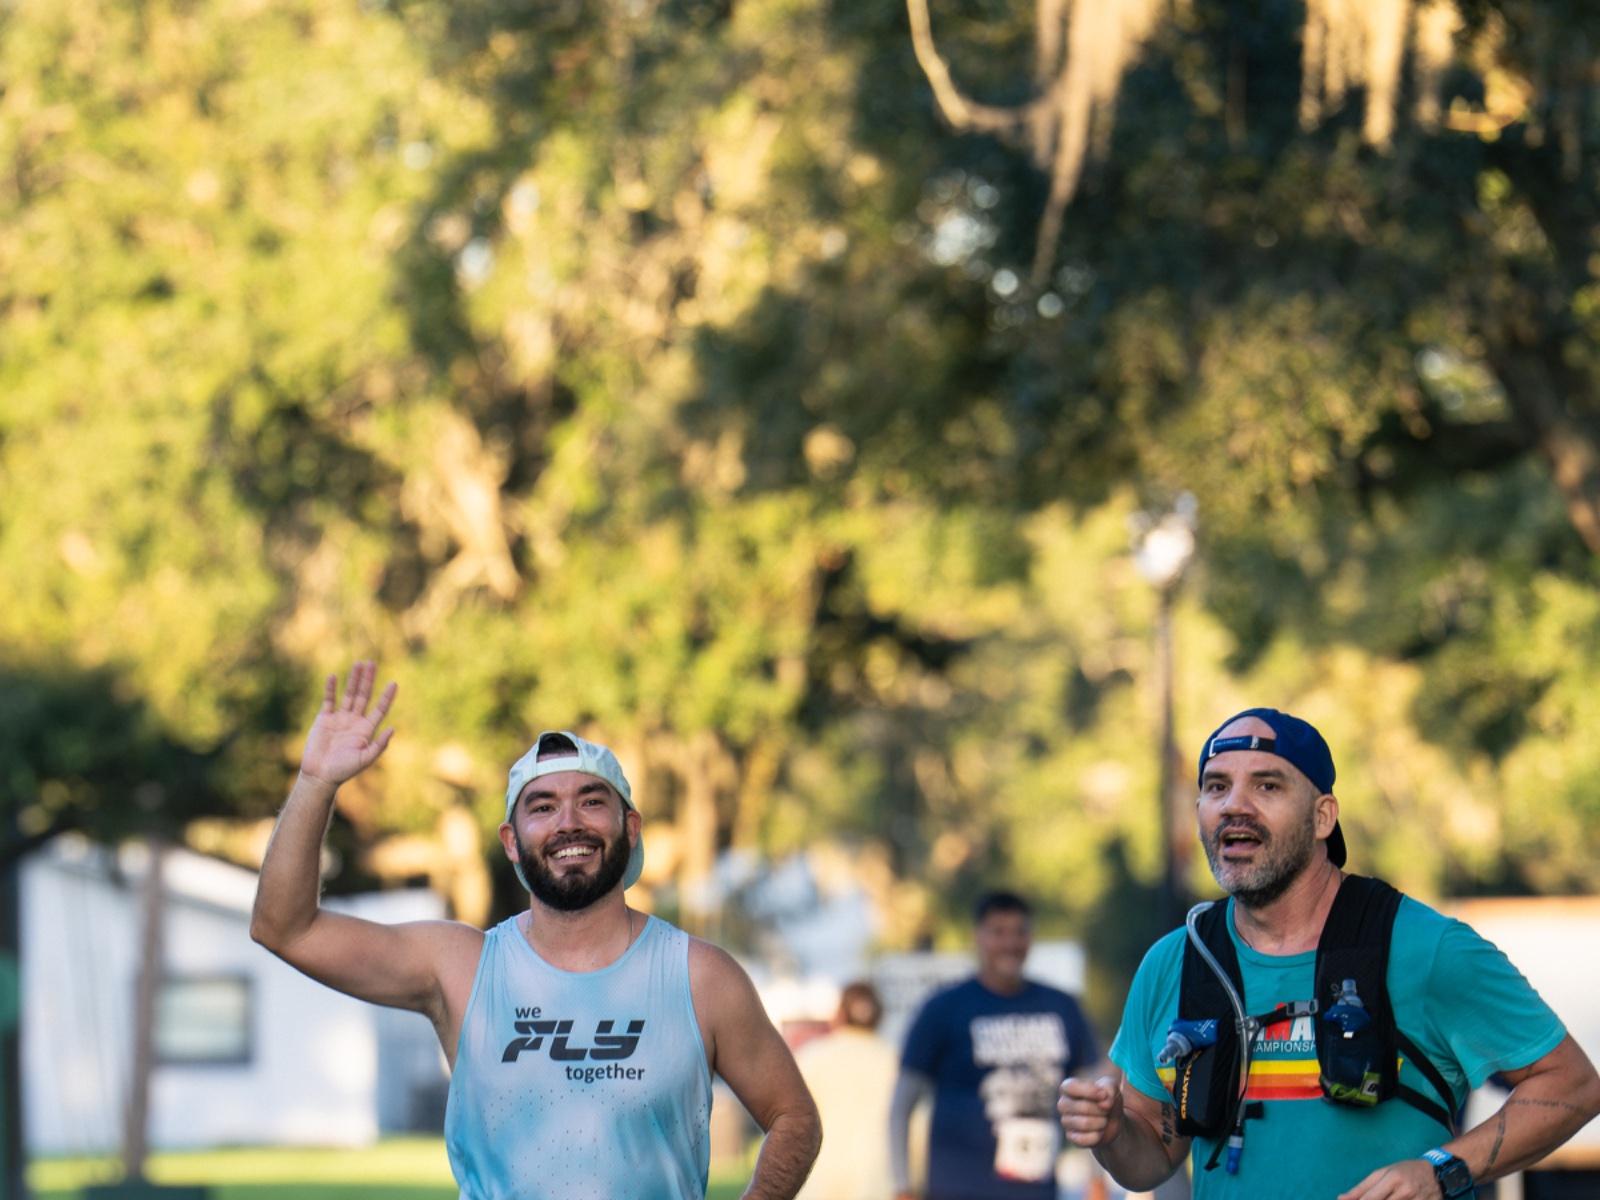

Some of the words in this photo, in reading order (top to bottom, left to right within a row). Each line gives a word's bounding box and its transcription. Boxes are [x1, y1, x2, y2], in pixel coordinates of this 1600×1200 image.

[515, 1006, 541, 1019] we
[501, 1019, 645, 1063] FLY
[565, 1063, 645, 1084] together
